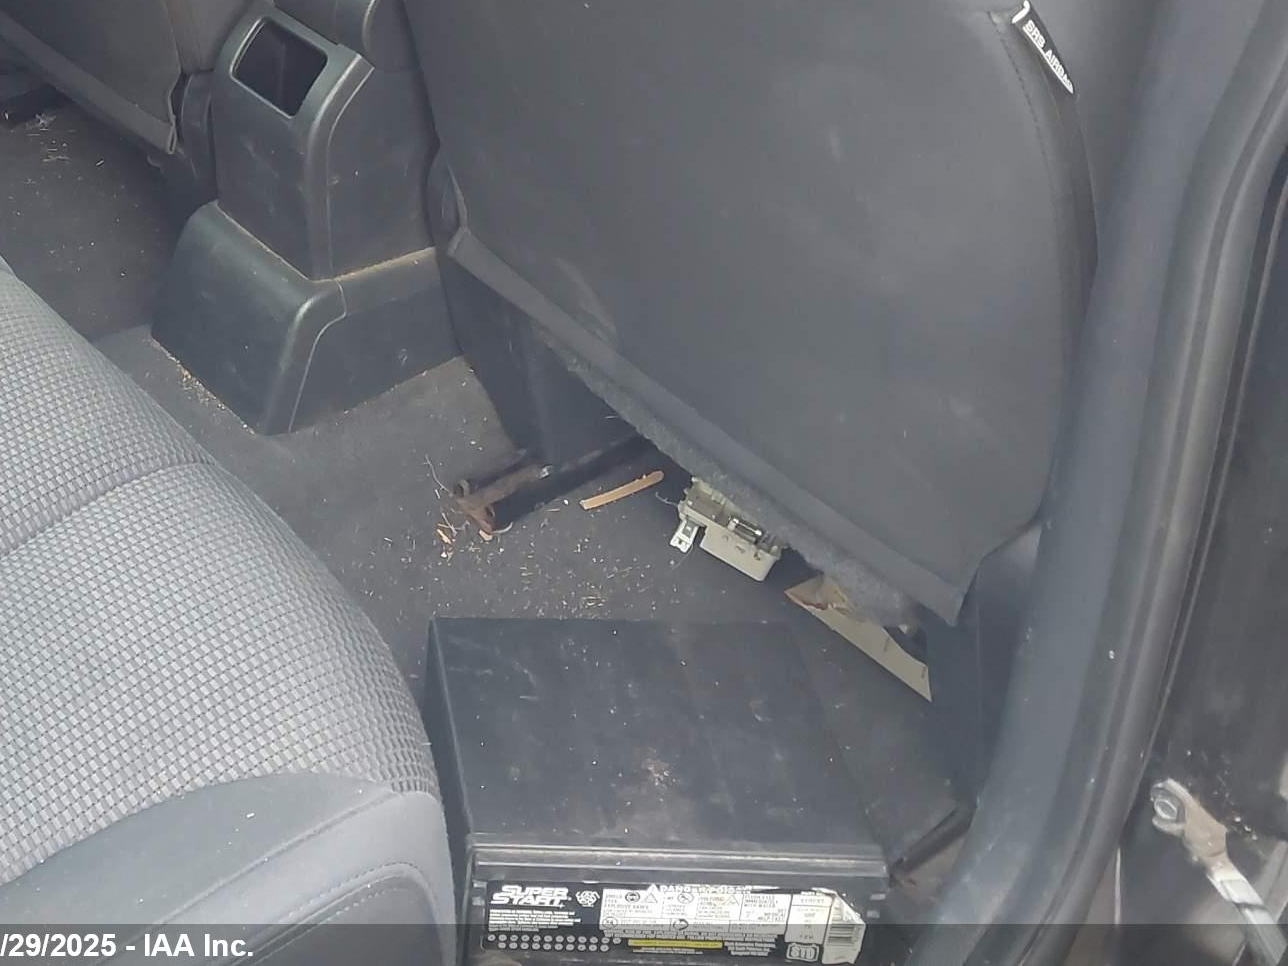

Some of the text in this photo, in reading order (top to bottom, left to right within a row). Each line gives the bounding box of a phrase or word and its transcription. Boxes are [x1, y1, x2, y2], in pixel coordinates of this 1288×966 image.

[1024, 19, 1046, 48] SRS
[491, 892, 564, 907] START
[501, 884, 570, 901] SUPER
